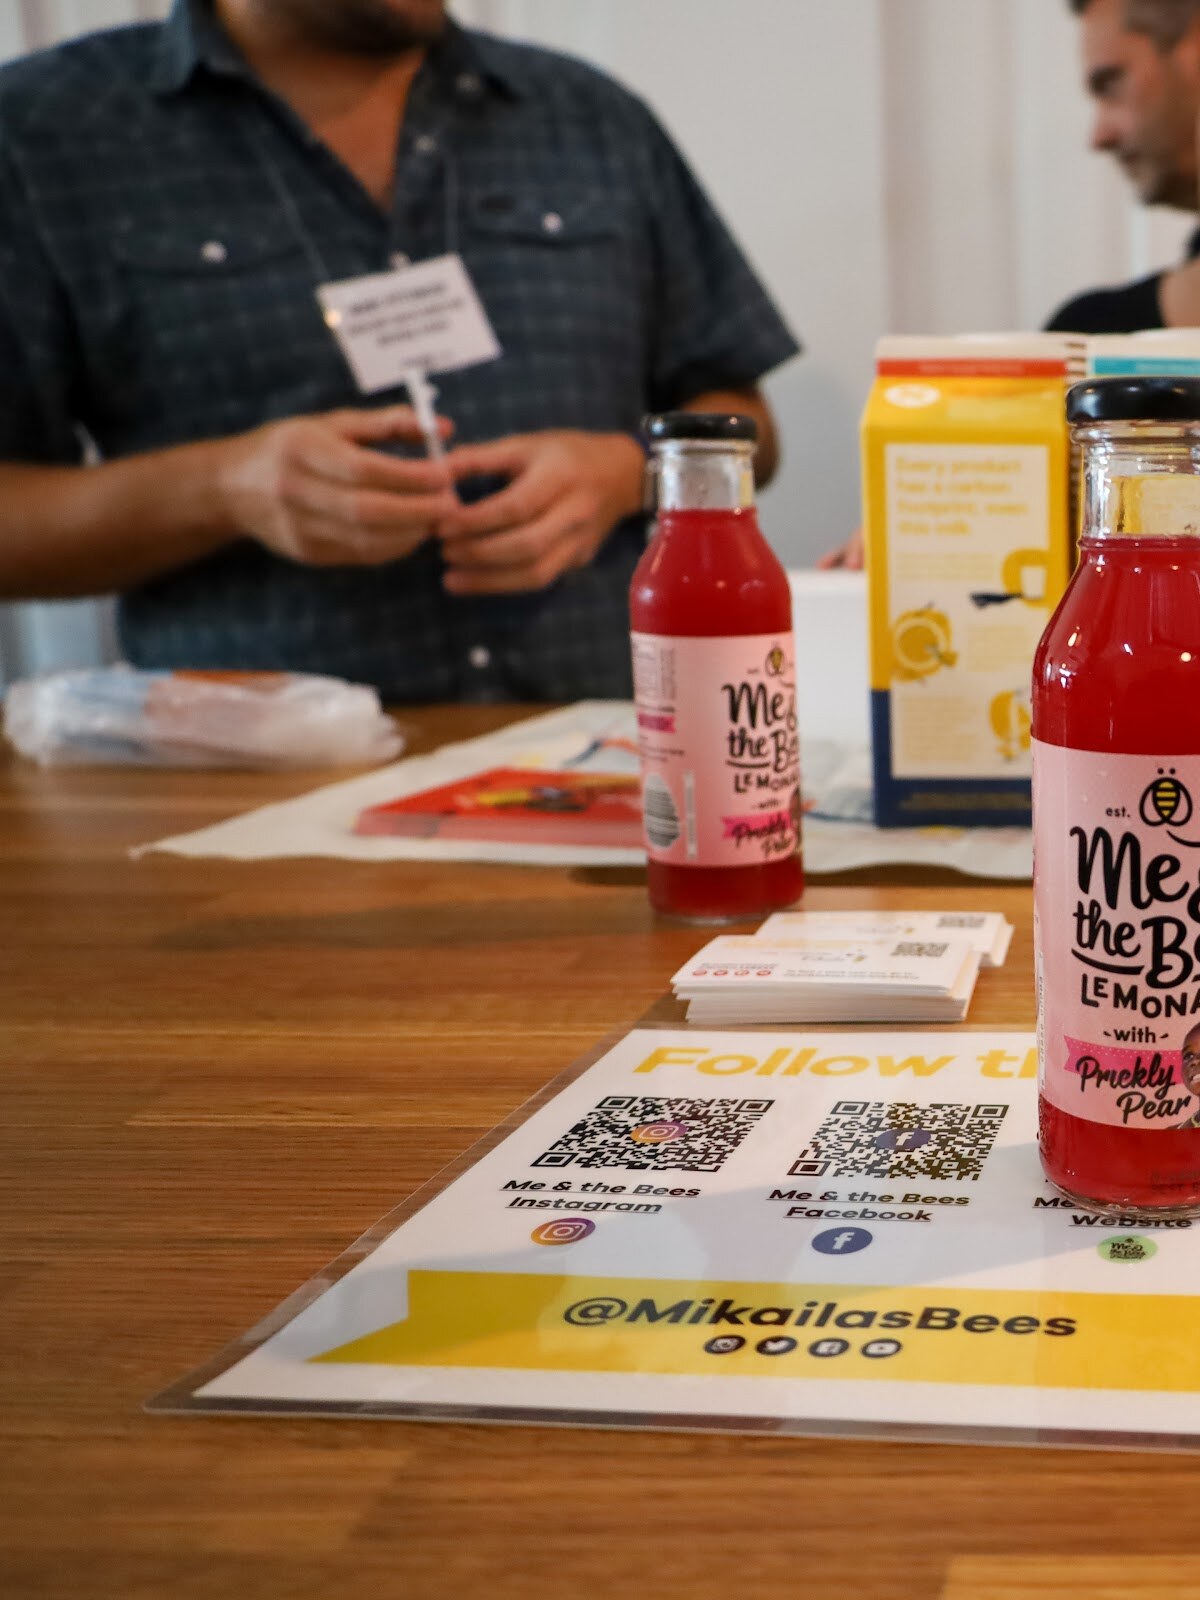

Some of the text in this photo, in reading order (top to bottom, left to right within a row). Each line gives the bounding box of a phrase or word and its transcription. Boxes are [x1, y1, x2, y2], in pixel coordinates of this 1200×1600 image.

[721, 682, 785, 728] Me
[727, 727, 767, 758] the
[1105, 807, 1131, 818] est.
[1069, 826, 1190, 910] Me
[1073, 899, 1141, 957] the
[1113, 1026, 1156, 1043] with
[633, 1047, 957, 1077] Follow
[1076, 1053, 1176, 1099] Prickly
[1116, 1091, 1191, 1125] Pear
[503, 1180, 701, 1197] Me & the Bees
[768, 1189, 970, 1205] Me & the Bees
[508, 1196, 662, 1213] Instagram
[786, 1206, 933, 1221] Facebook
[1072, 1214, 1192, 1228] Website
[563, 1296, 1078, 1337] @MikailasBees
